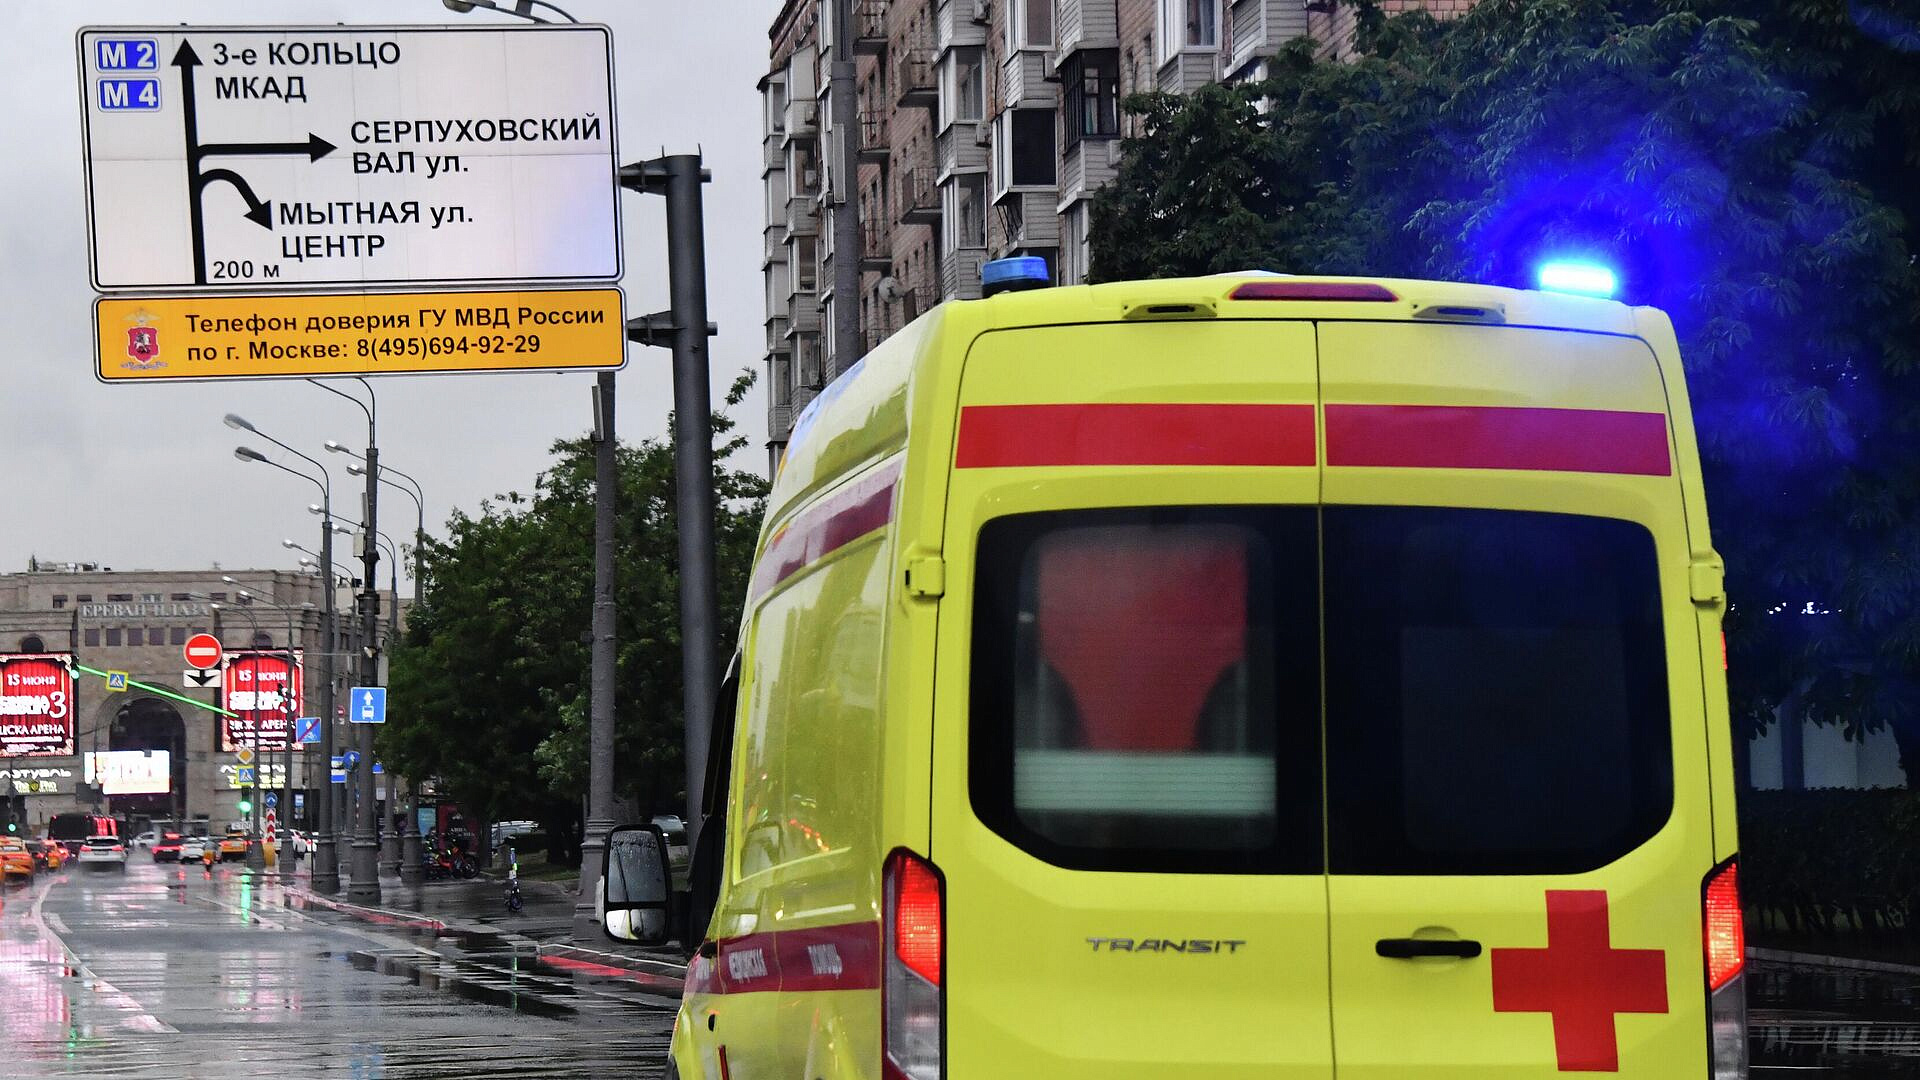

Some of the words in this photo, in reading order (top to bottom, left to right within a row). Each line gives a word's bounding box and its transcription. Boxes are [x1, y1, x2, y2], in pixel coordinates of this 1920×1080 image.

[136, 43, 155, 68] 2
[213, 43, 257, 65] 3-е
[269, 41, 401, 69] КОЛЬЦО
[138, 81, 158, 107] 4
[215, 76, 306, 103] МКАД
[350, 113, 602, 144] СЕРПУХОВСКИЙ
[352, 151, 416, 175] ВАЛ
[426, 154, 469, 180] ул.
[279, 201, 420, 225] МЫТНАЯ
[431, 204, 474, 230] ул.
[281, 235, 385, 262] ЦЕНТР
[213, 261, 254, 279] 200
[262, 265, 280, 279] м
[185, 313, 297, 335] Телефон
[305, 313, 410, 333] доверия
[418, 309, 448, 328] ГУ
[455, 308, 510, 328] МВД
[518, 307, 604, 326] России
[187, 345, 217, 361] по
[226, 345, 240, 360] г.
[249, 341, 348, 360] Москве:
[357, 334, 541, 361] 8(495)694-92-29
[82, 604, 146, 617] ЕРЕВАН
[1085, 936, 1246, 954] TRANSIT
